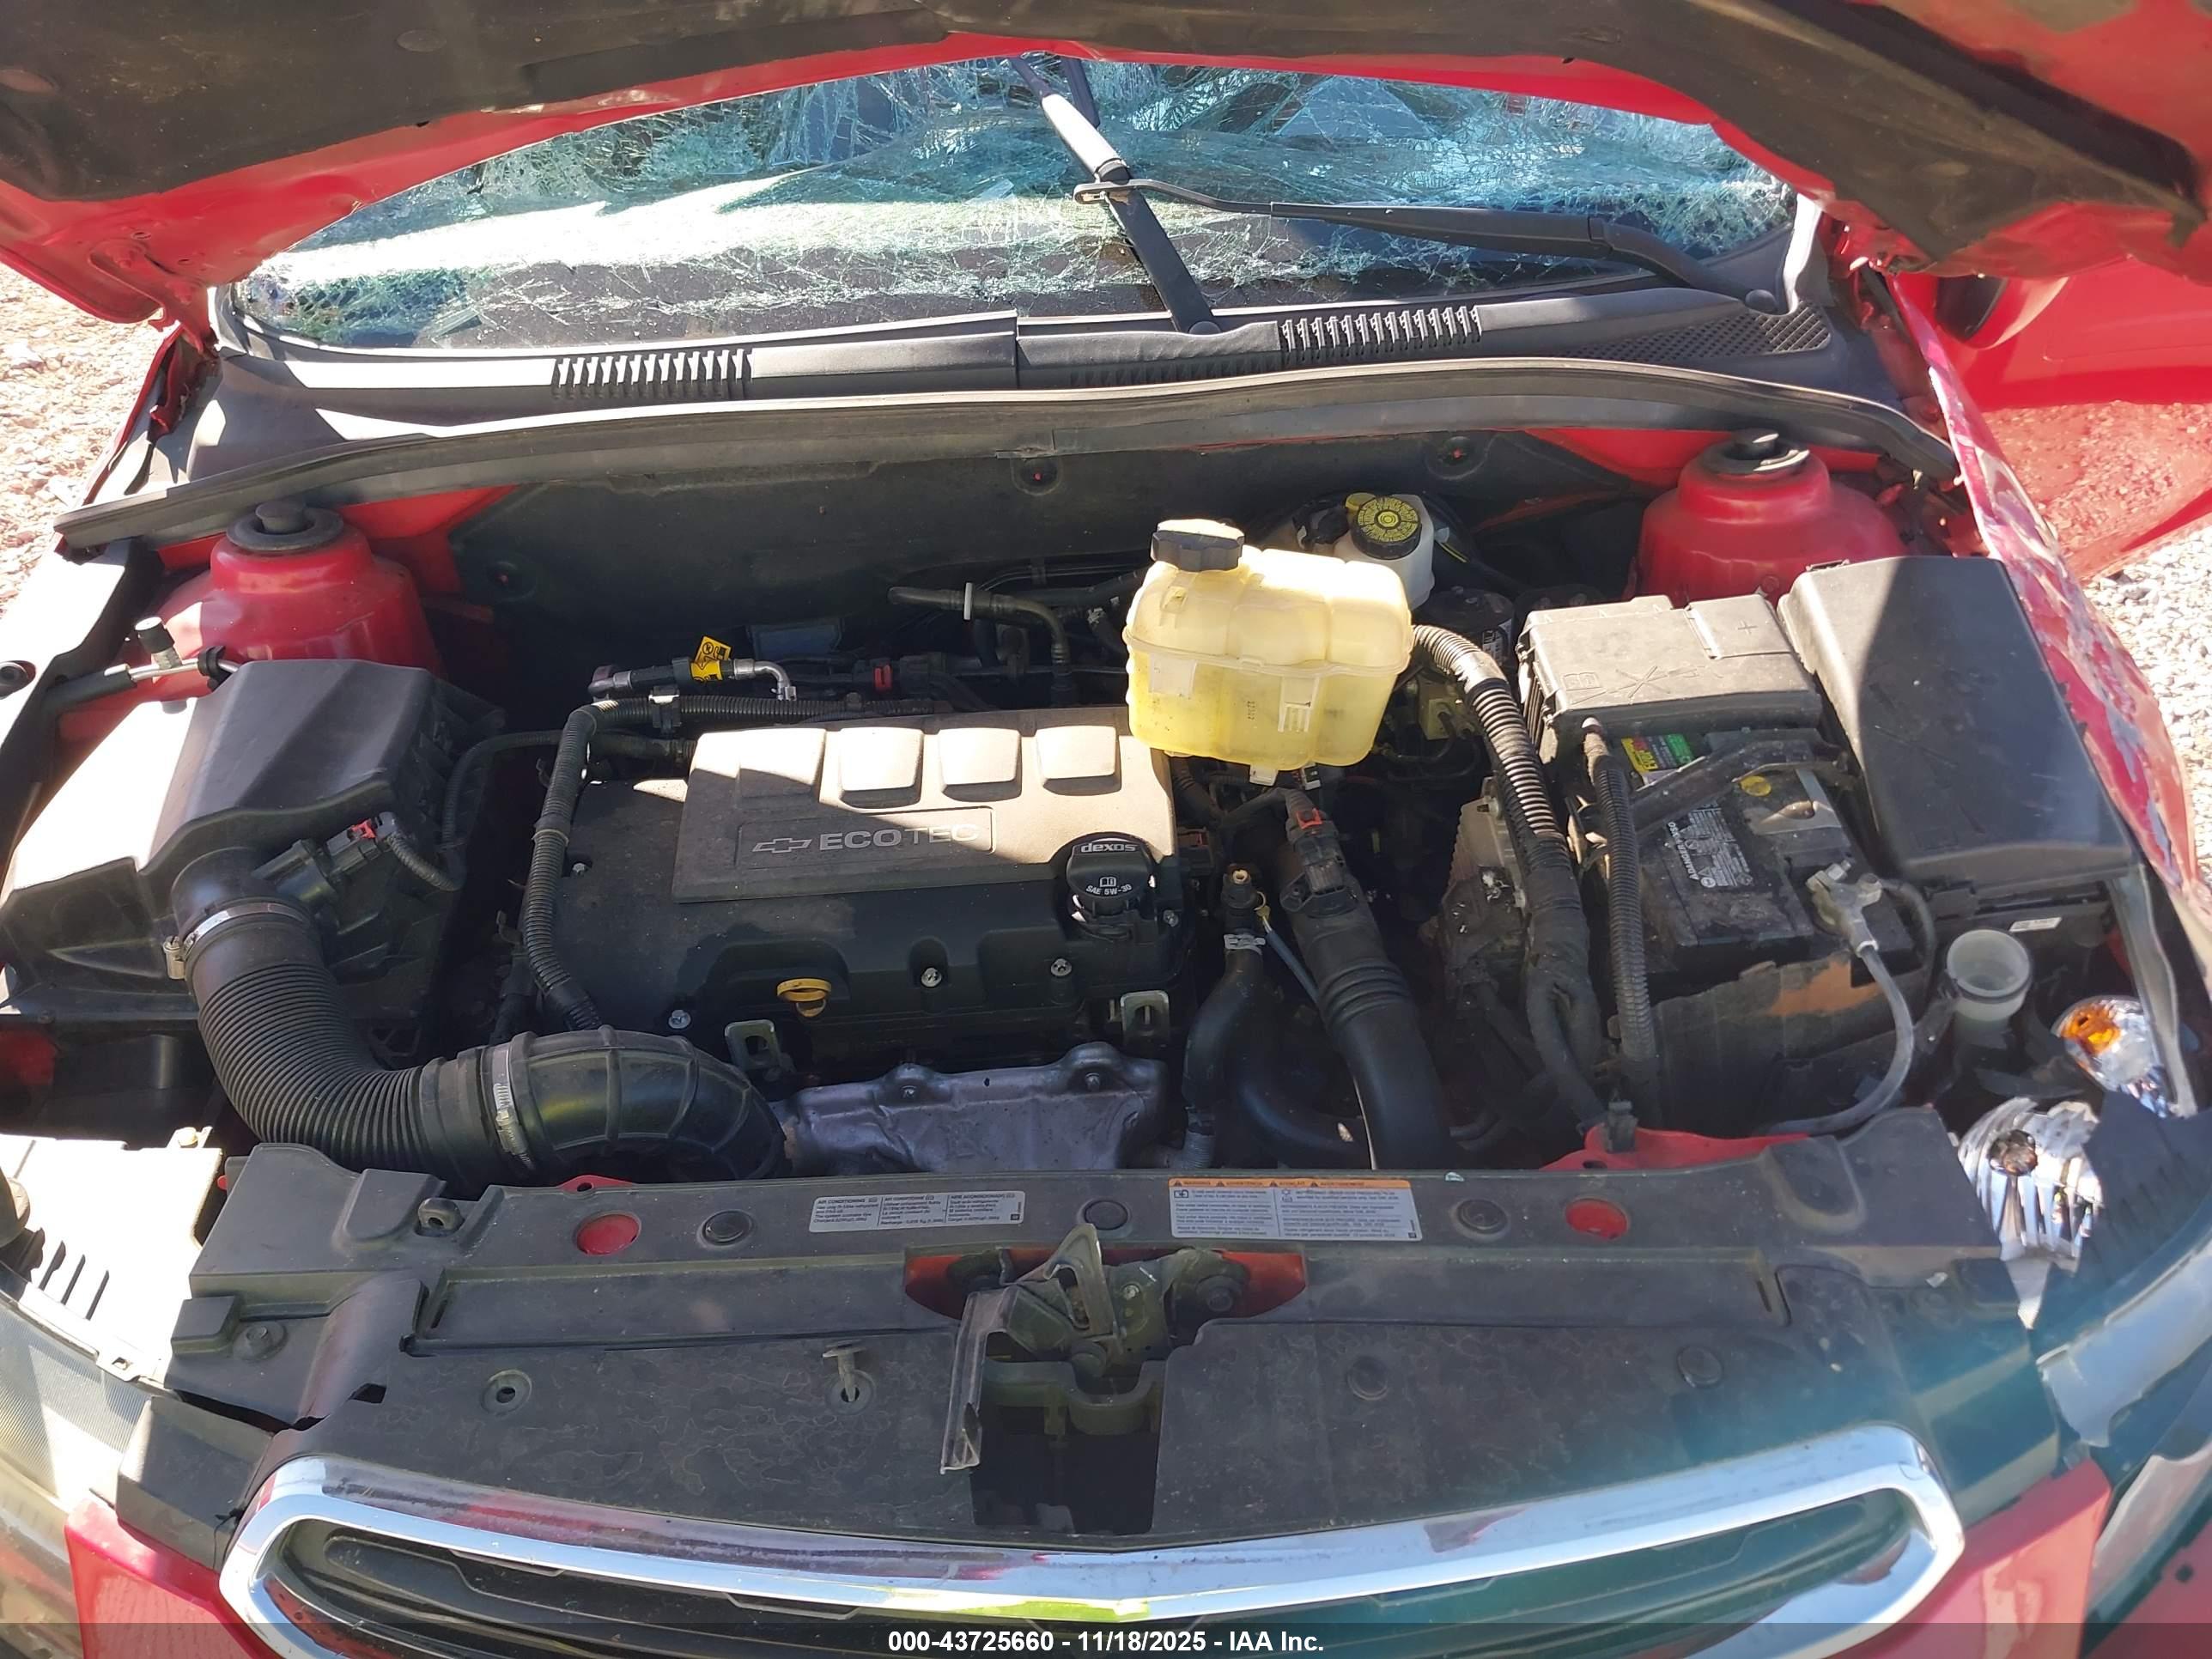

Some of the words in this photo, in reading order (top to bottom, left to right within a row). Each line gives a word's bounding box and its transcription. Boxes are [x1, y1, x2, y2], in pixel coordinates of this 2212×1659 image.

[820, 824, 979, 851] ECOTEC
[1081, 842, 1135, 853] dexos
[1085, 884, 1102, 895] SAE
[1104, 884, 1133, 896] 5W-30
